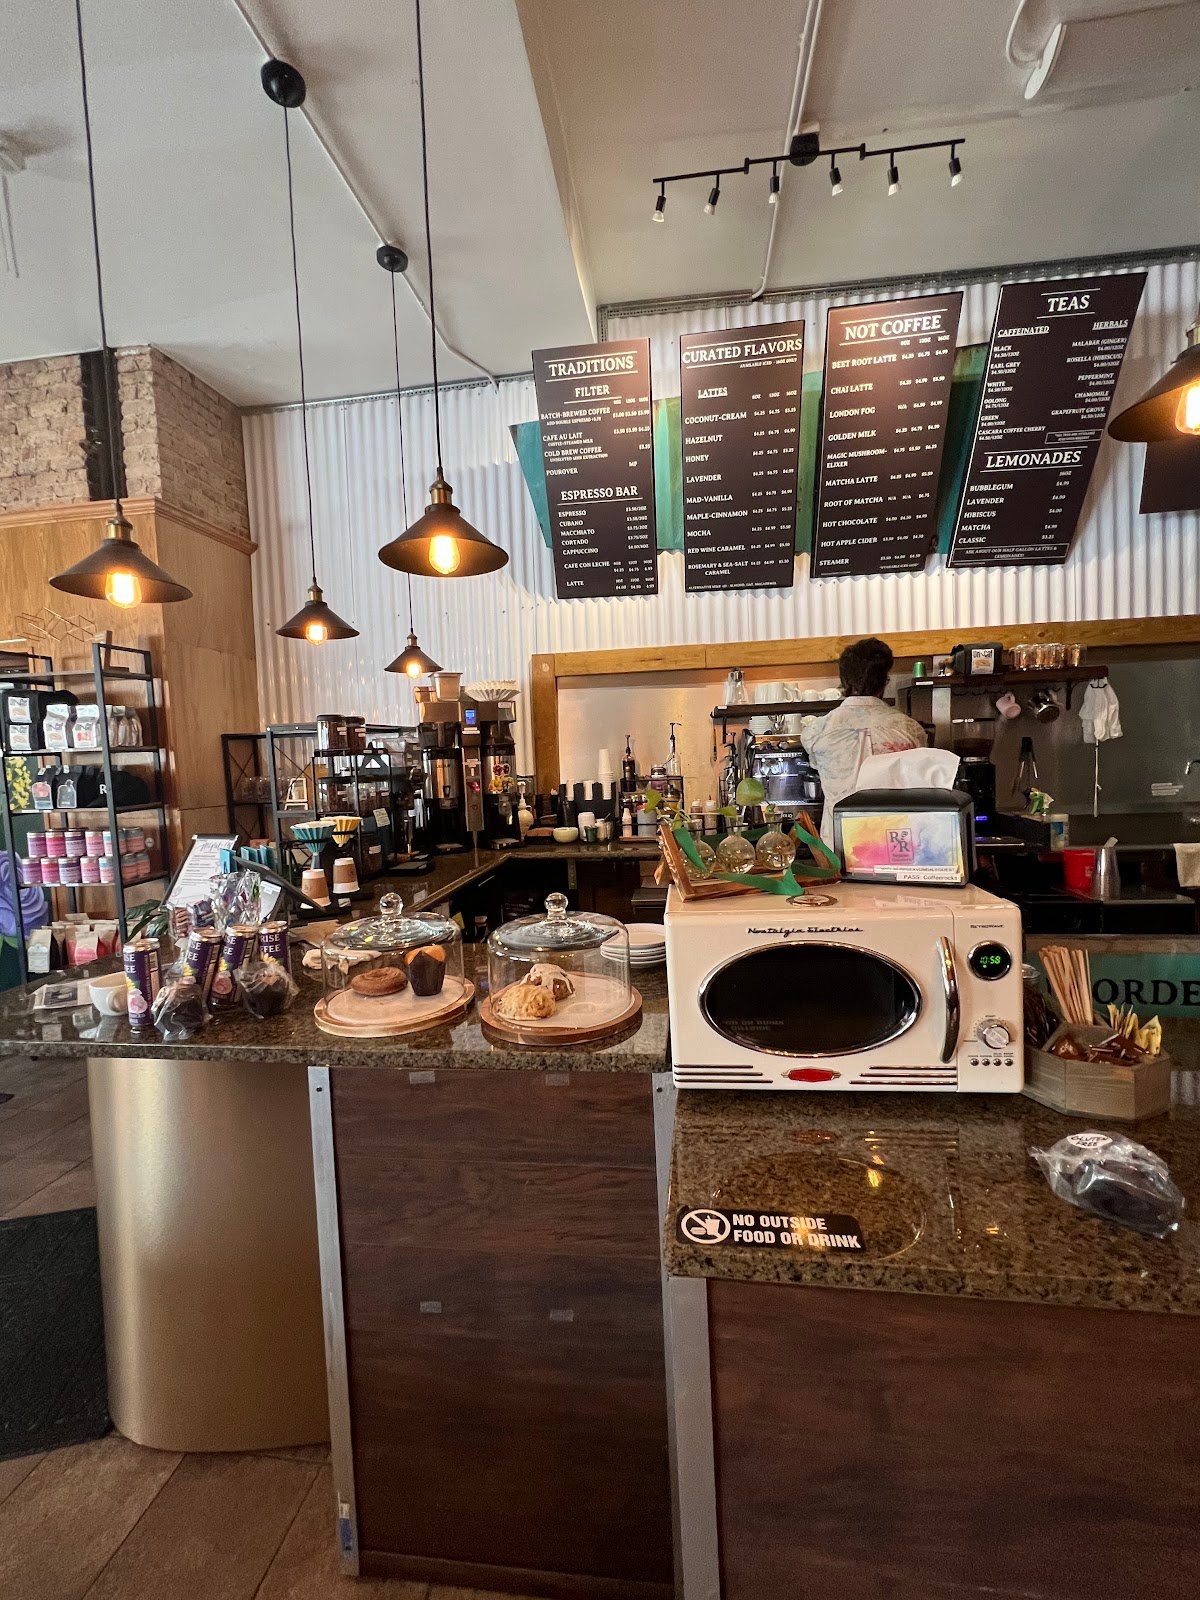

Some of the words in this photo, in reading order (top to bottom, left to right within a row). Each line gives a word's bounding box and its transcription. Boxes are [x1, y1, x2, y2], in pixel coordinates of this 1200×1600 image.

[1048, 295, 1090, 312] TEAS
[845, 323, 879, 340] NOT
[882, 315, 942, 335] COFFEE
[1093, 320, 1128, 330] HERBALS
[998, 326, 1049, 337] CAFFEINATED
[683, 346, 741, 364] CURATED
[744, 339, 802, 356] FLAVORS
[549, 356, 634, 377] TRADITIONS
[832, 360, 850, 369] BEET
[852, 357, 872, 366] ROOT
[874, 354, 897, 363] LATTE
[575, 385, 610, 398] FILTER
[698, 387, 728, 399] LATTES
[831, 385, 848, 394] CHAI
[850, 383, 873, 392] LATTE
[541, 410, 587, 420] BATCH-BREWED
[588, 407, 610, 415] COFFEE
[685, 412, 746, 424] COCONUT-CREAM
[830, 409, 860, 418] LONDON
[861, 407, 875, 415] FOG
[686, 435, 723, 444] HAZELNUT
[828, 432, 856, 441] GOLDEN
[858, 430, 876, 438] MILK
[580, 446, 602, 454] COFFEE
[827, 452, 847, 460] MAGIC
[849, 448, 887, 458] MUSHROOM-
[686, 454, 709, 463] HONEY
[986, 451, 1082, 468] LEMONADES
[546, 468, 578, 476] POUROVER
[687, 474, 721, 483] LAVENDER
[826, 478, 854, 486] MATCHA
[561, 488, 613, 500] ESPRESSO
[616, 486, 638, 496] BAR
[970, 484, 1014, 492] BUBBLEGUM
[687, 495, 733, 503] MAD-VANILLA
[967, 497, 1004, 505] LAVENDER
[687, 510, 748, 520] MAPLE-CINNAMON
[838, 517, 877, 526] CHOCOLATE
[836, 538, 856, 546] APPLE
[688, 562, 717, 570] ROSEMARY
[819, 558, 849, 566] STEAMER
[980, 956, 1001, 964] 10:58
[733, 1214, 755, 1226] NO
[760, 1215, 827, 1230] OUTSIDE
[733, 1229, 775, 1243] FOOD
[780, 1232, 803, 1245] OR
[808, 1234, 861, 1248] DRINK
